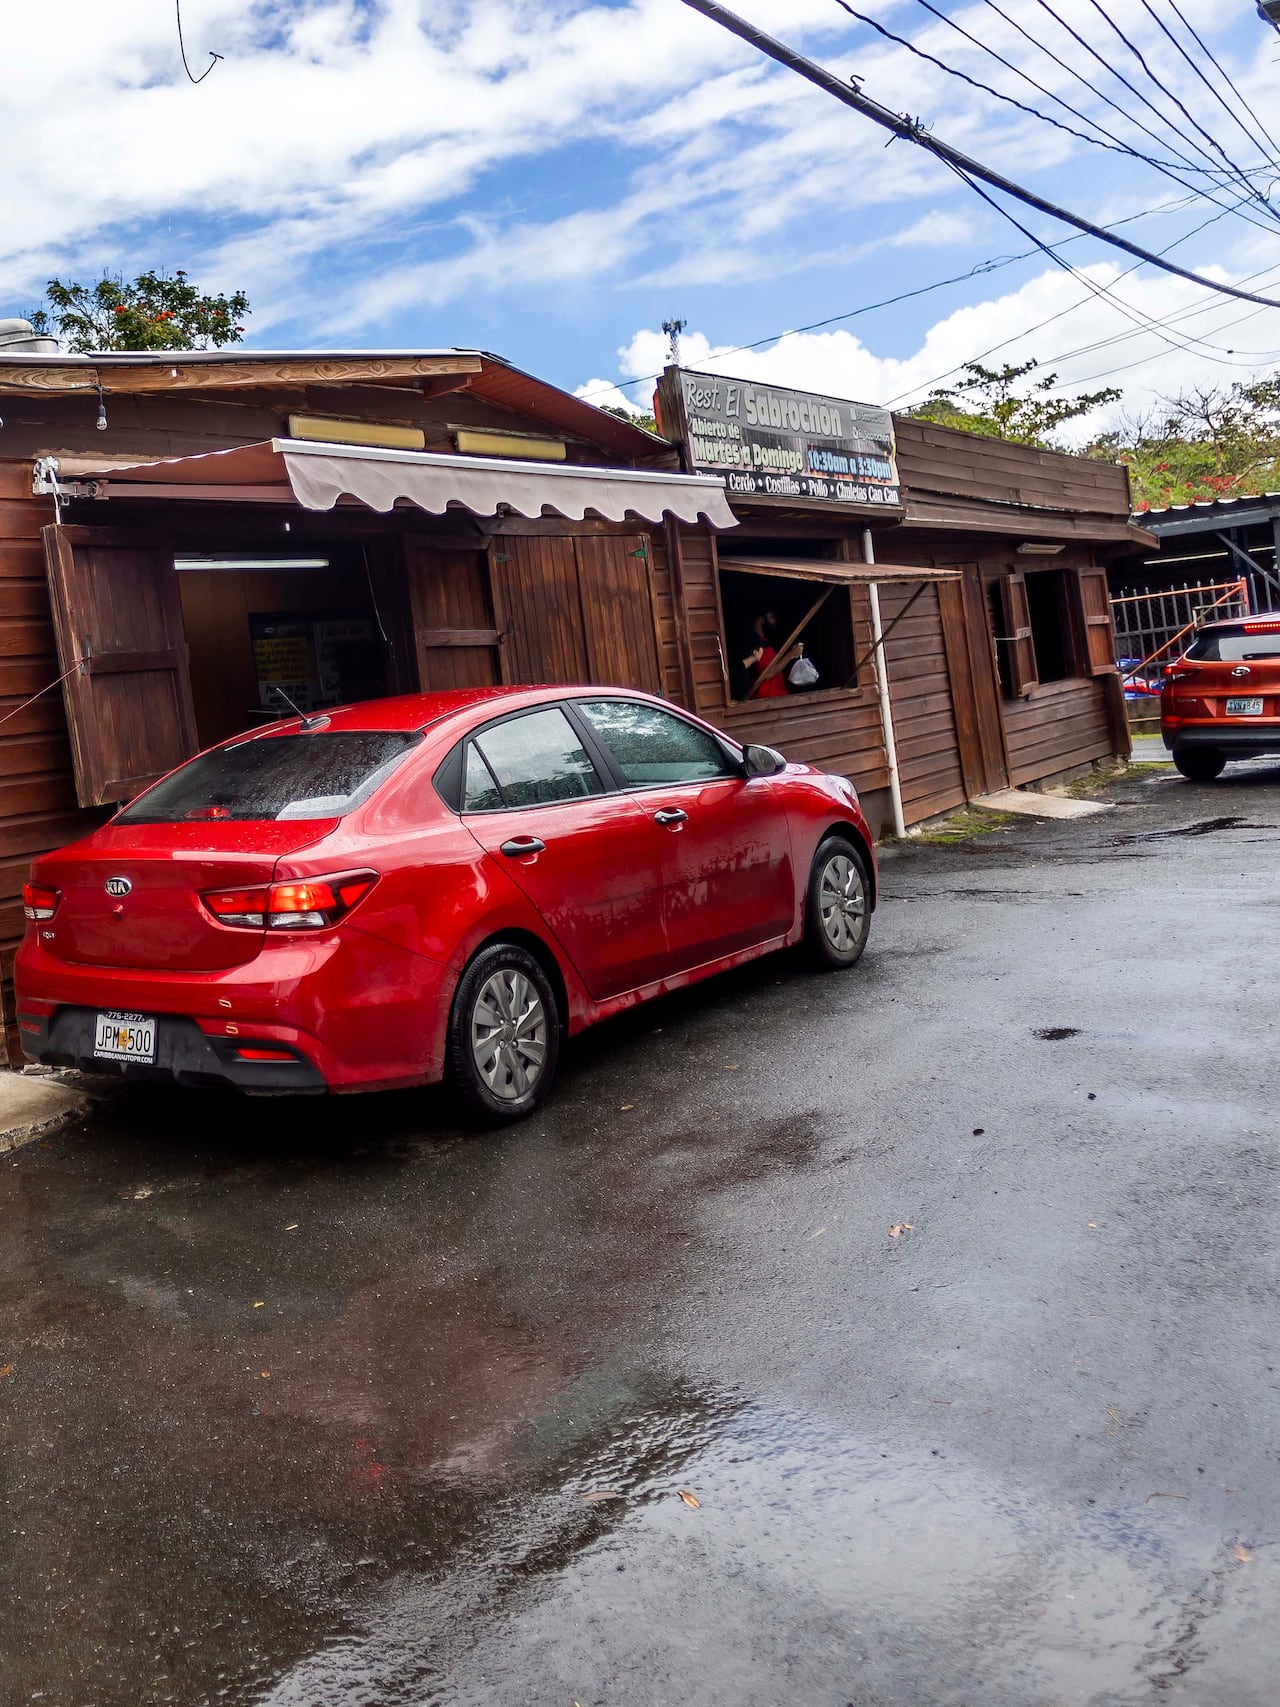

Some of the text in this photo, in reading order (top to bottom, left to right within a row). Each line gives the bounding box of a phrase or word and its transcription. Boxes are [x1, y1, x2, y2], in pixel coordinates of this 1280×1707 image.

[686, 380, 843, 437] Rest. El Sabrochón
[692, 418, 740, 439] Abierto de
[694, 437, 803, 473] Martes a Domingo
[808, 450, 892, 480] 10:30am a 3:30pm
[729, 472, 756, 491] Cerdo
[765, 476, 800, 494] Costillas
[808, 480, 829, 498] Pollo
[836, 482, 867, 501] Chuletas
[868, 486, 883, 502] Can
[883, 487, 899, 502] Can
[107, 881, 126, 893] KIA
[98, 1025, 151, 1052] JPM 500
